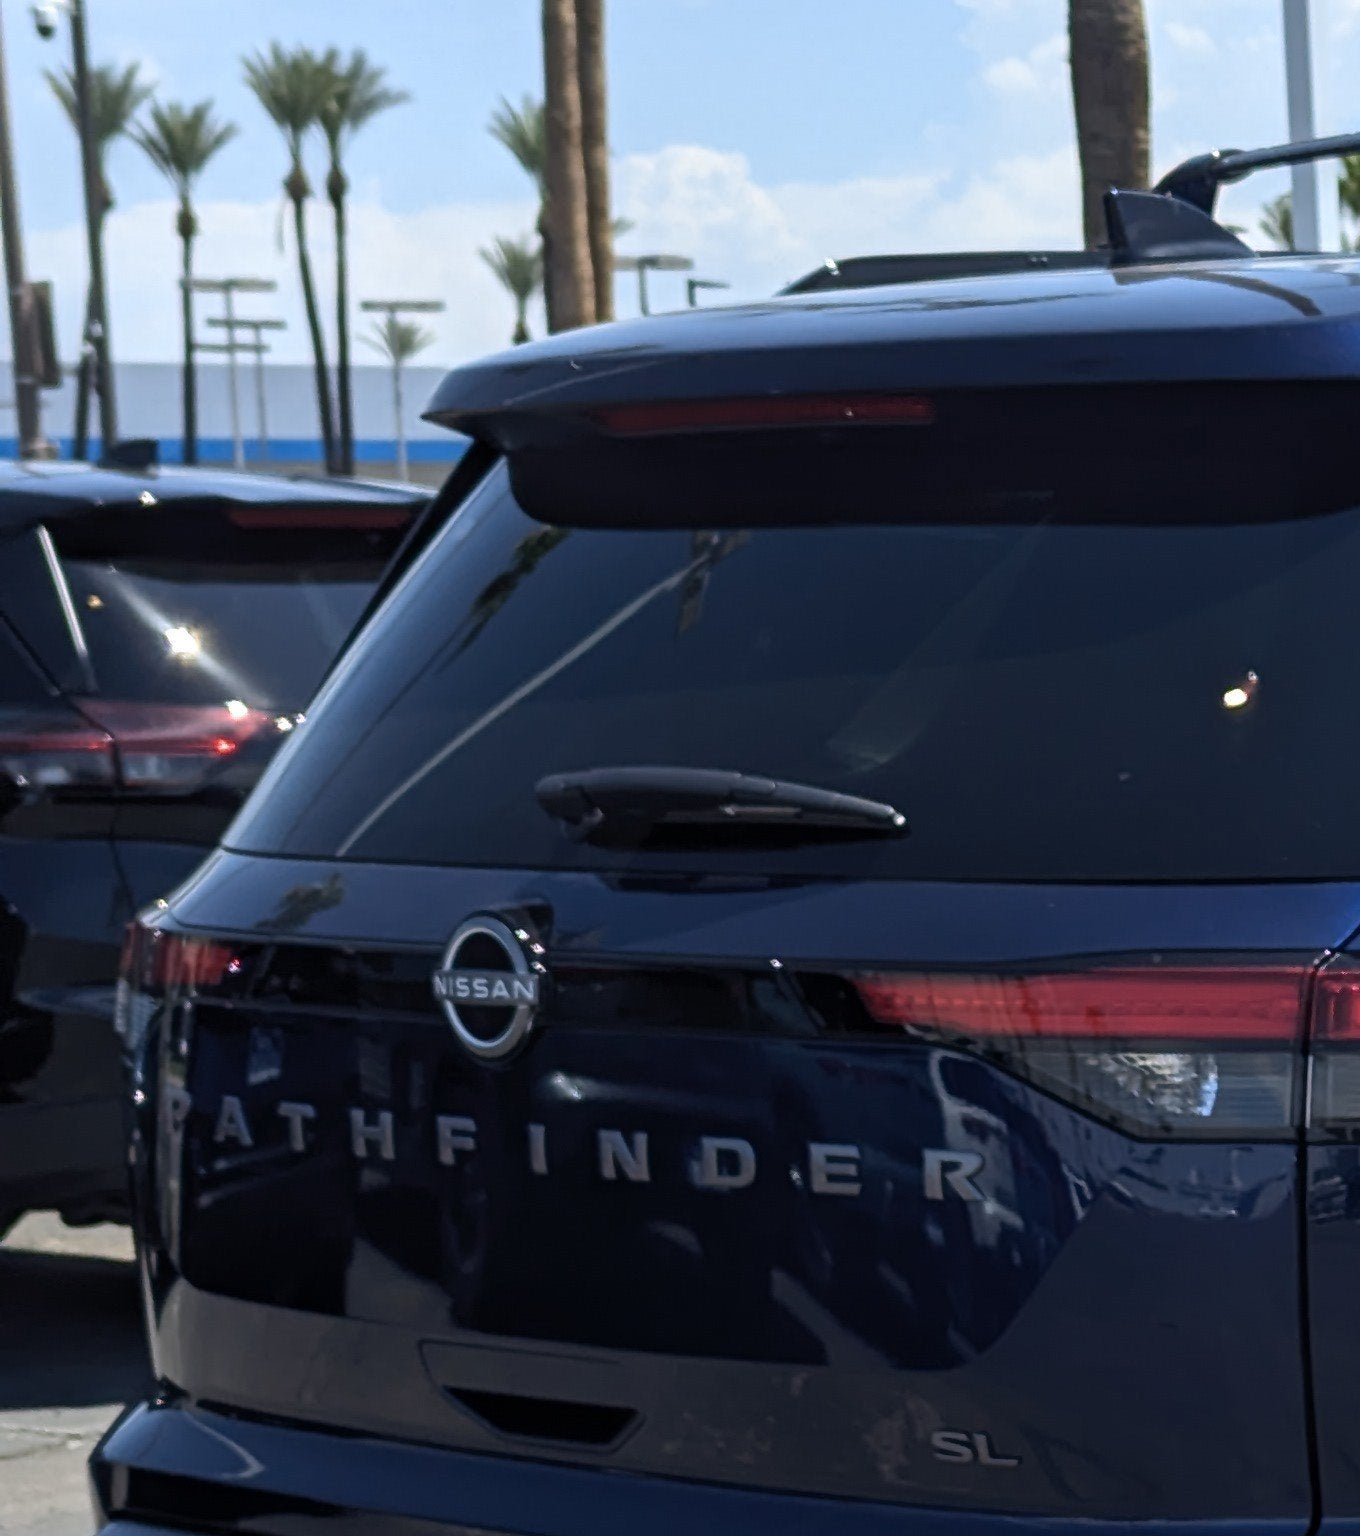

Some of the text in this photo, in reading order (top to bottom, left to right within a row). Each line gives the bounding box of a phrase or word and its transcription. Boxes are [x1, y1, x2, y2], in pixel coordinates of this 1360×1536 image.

[433, 976, 536, 1000] NISSAN
[157, 1085, 986, 1201] PATHFINDER
[931, 1430, 1020, 1467] SL
